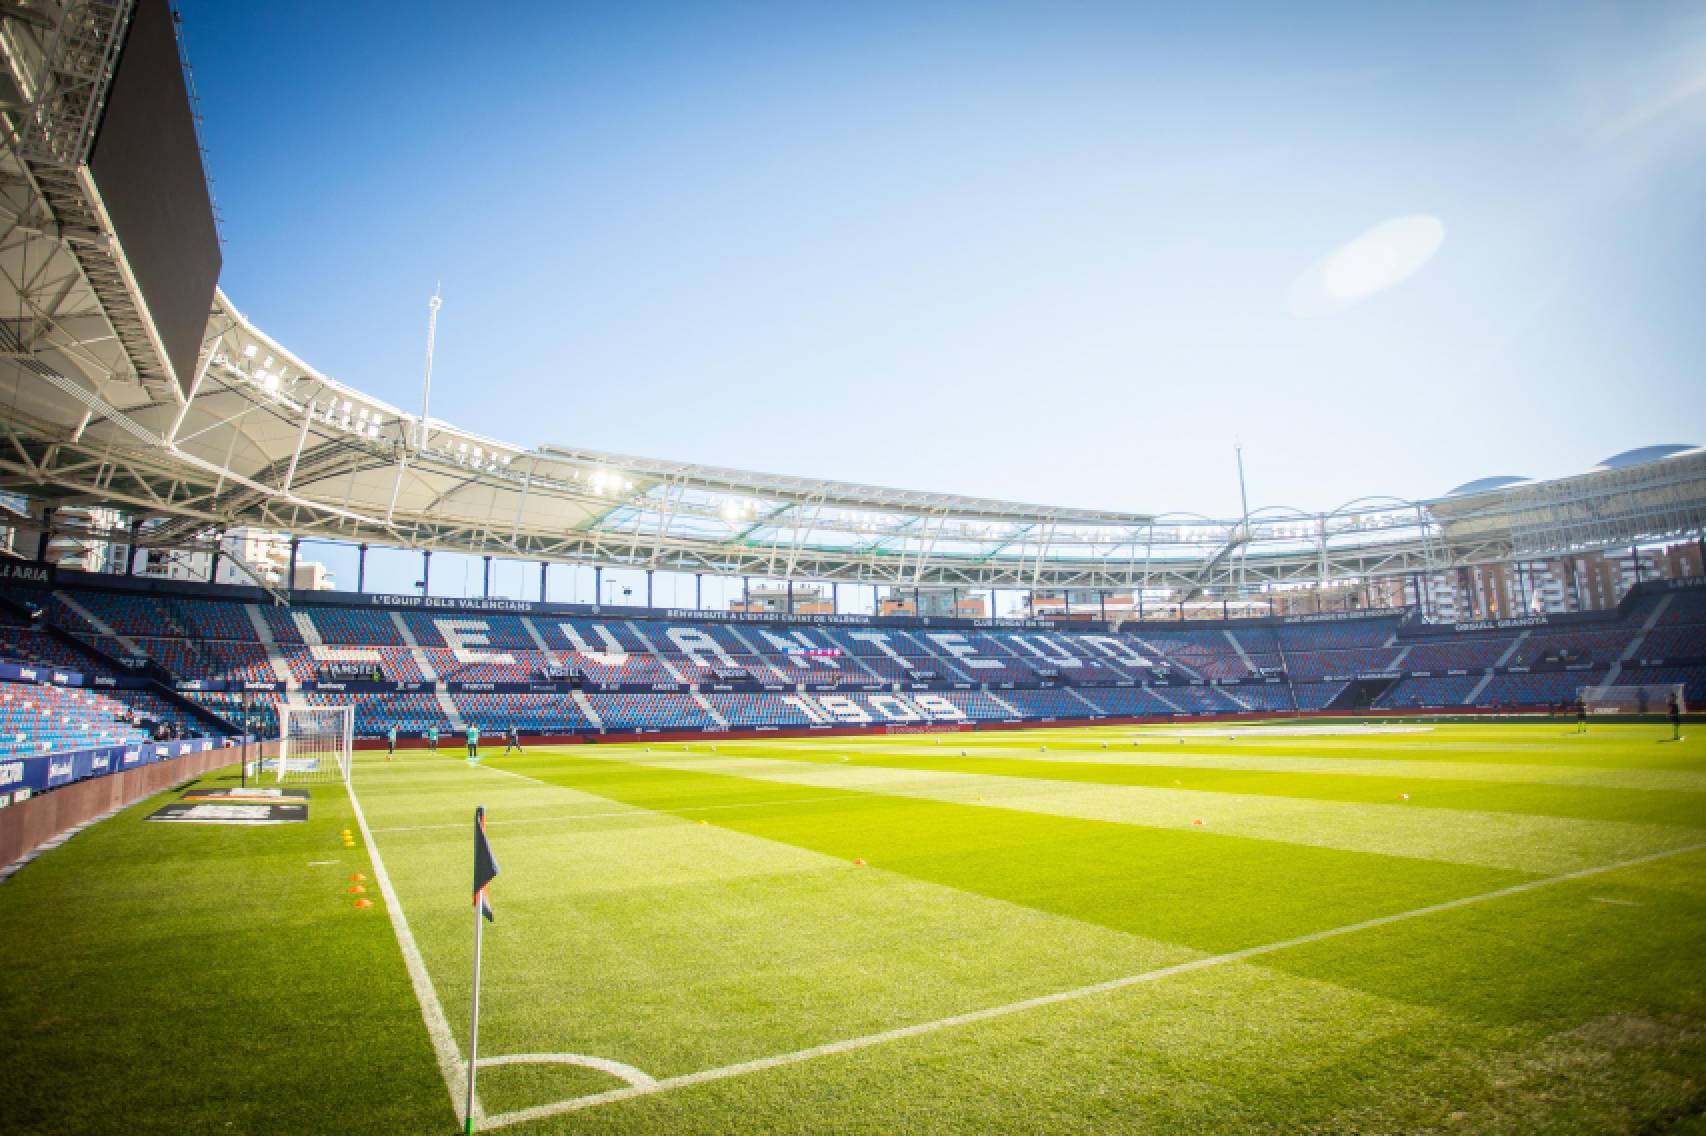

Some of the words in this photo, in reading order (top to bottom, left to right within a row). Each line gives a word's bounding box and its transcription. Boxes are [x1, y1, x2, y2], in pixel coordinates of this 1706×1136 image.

[372, 595, 420, 606] L'EQUIP
[426, 597, 455, 607] DELS
[782, 695, 967, 723] 1909
